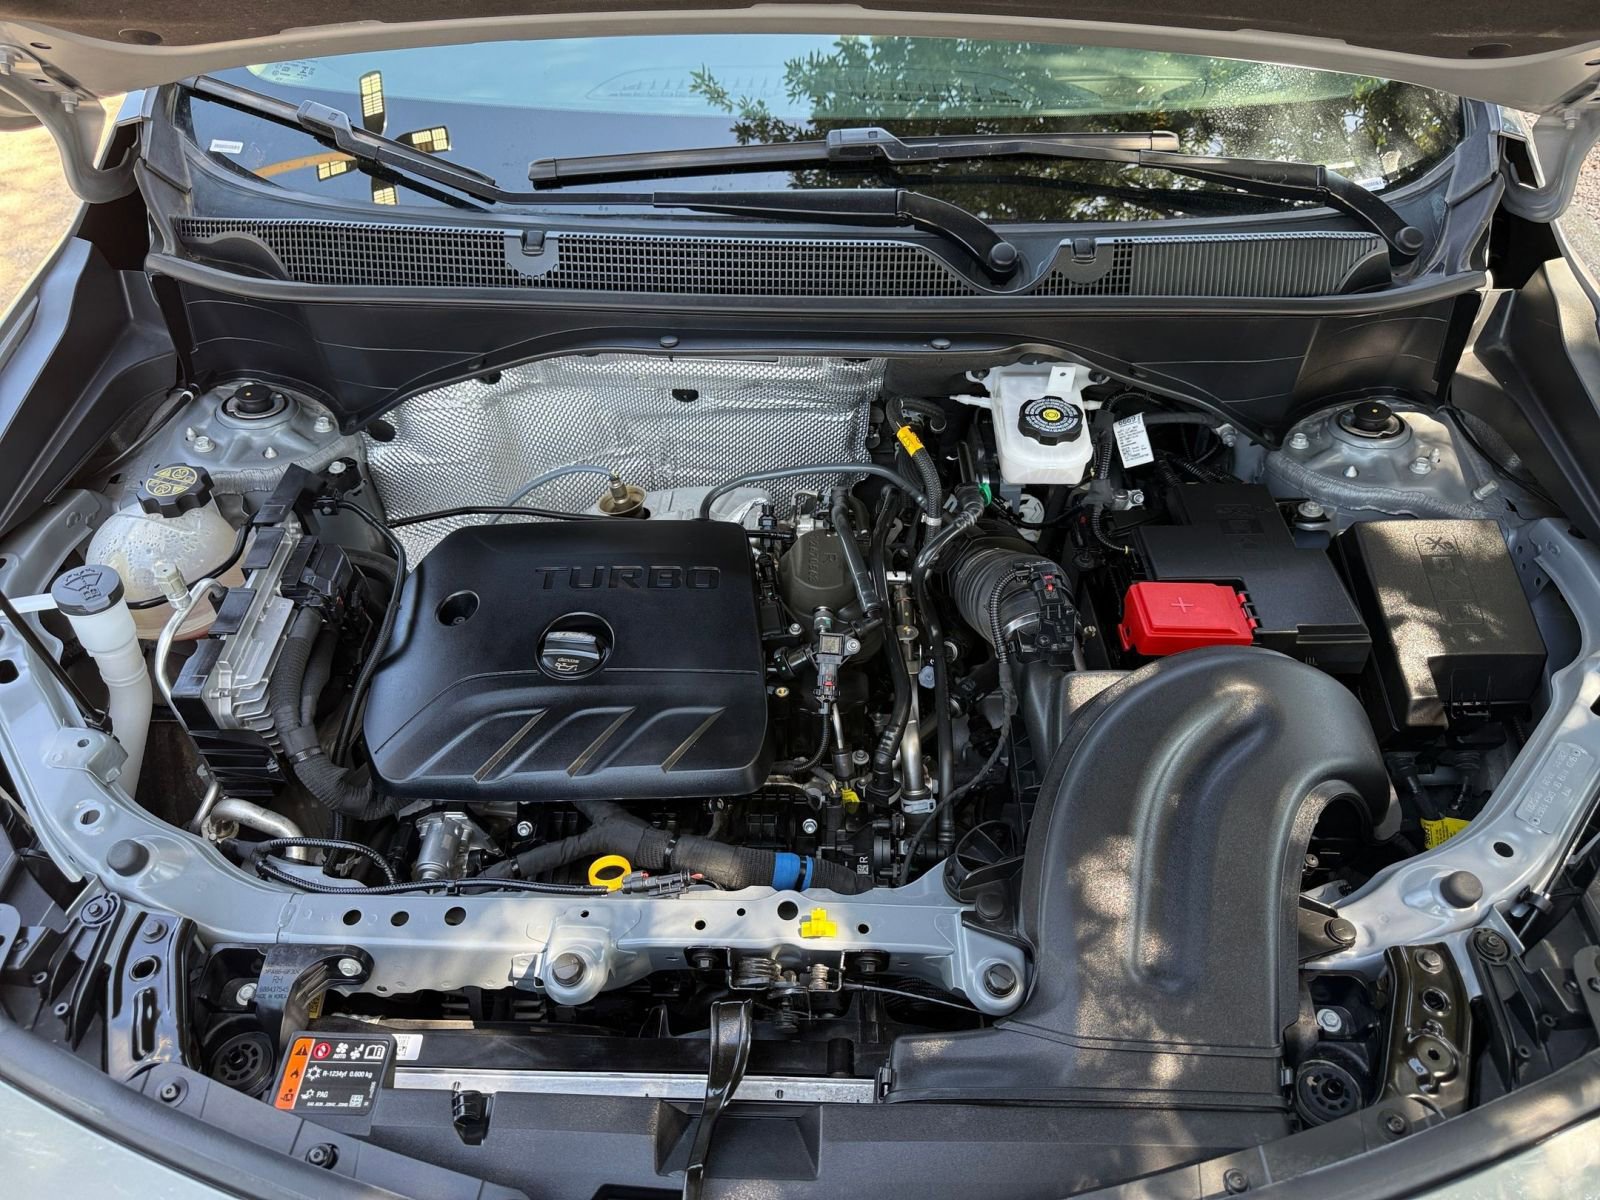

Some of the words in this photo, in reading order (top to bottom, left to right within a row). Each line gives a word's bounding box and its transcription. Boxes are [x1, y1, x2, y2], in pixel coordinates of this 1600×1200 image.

[535, 565, 721, 590] TURBO
[859, 856, 869, 864] R
[322, 1070, 348, 1078] R-1234yf
[364, 1071, 373, 1079] kg
[316, 1090, 329, 1098] PAG
